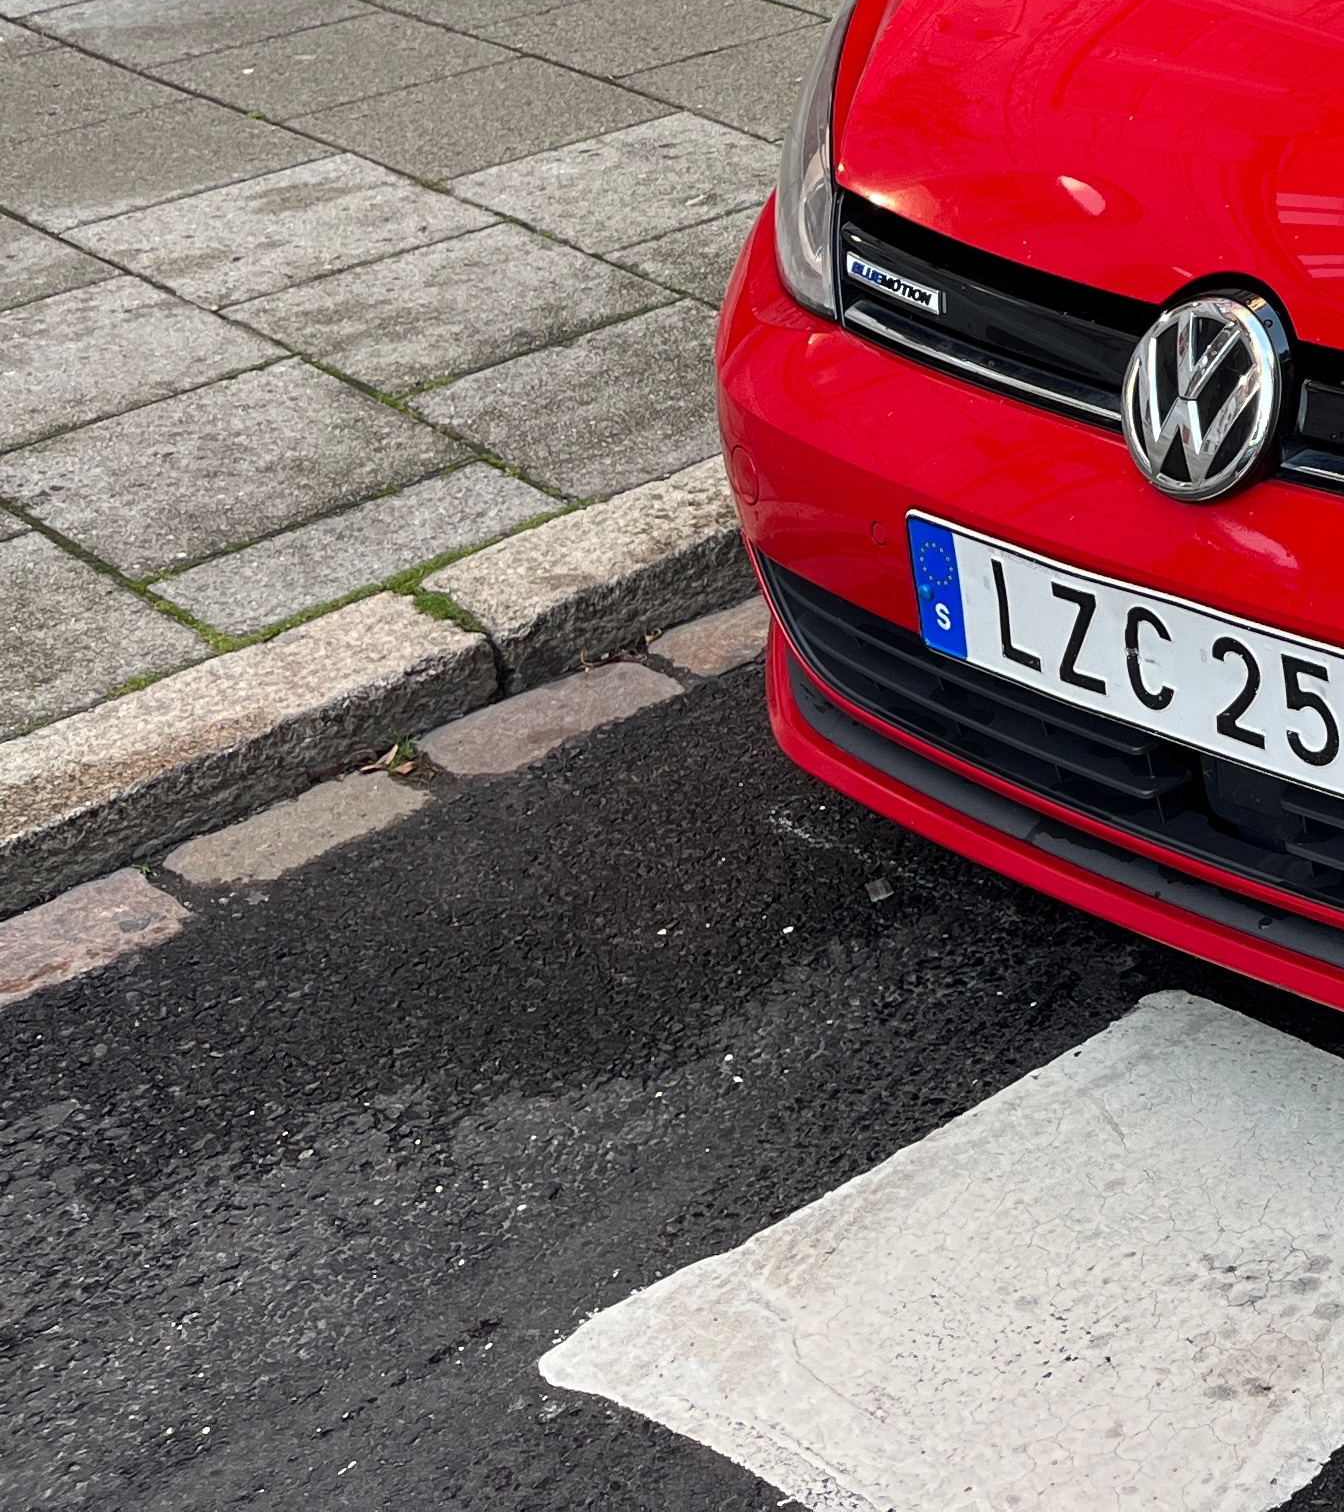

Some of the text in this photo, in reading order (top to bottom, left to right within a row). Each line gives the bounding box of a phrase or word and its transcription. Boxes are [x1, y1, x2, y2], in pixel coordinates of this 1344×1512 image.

[851, 261, 932, 306] BLUEMOTION
[935, 602, 952, 630] S
[990, 558, 1175, 710] LZC
